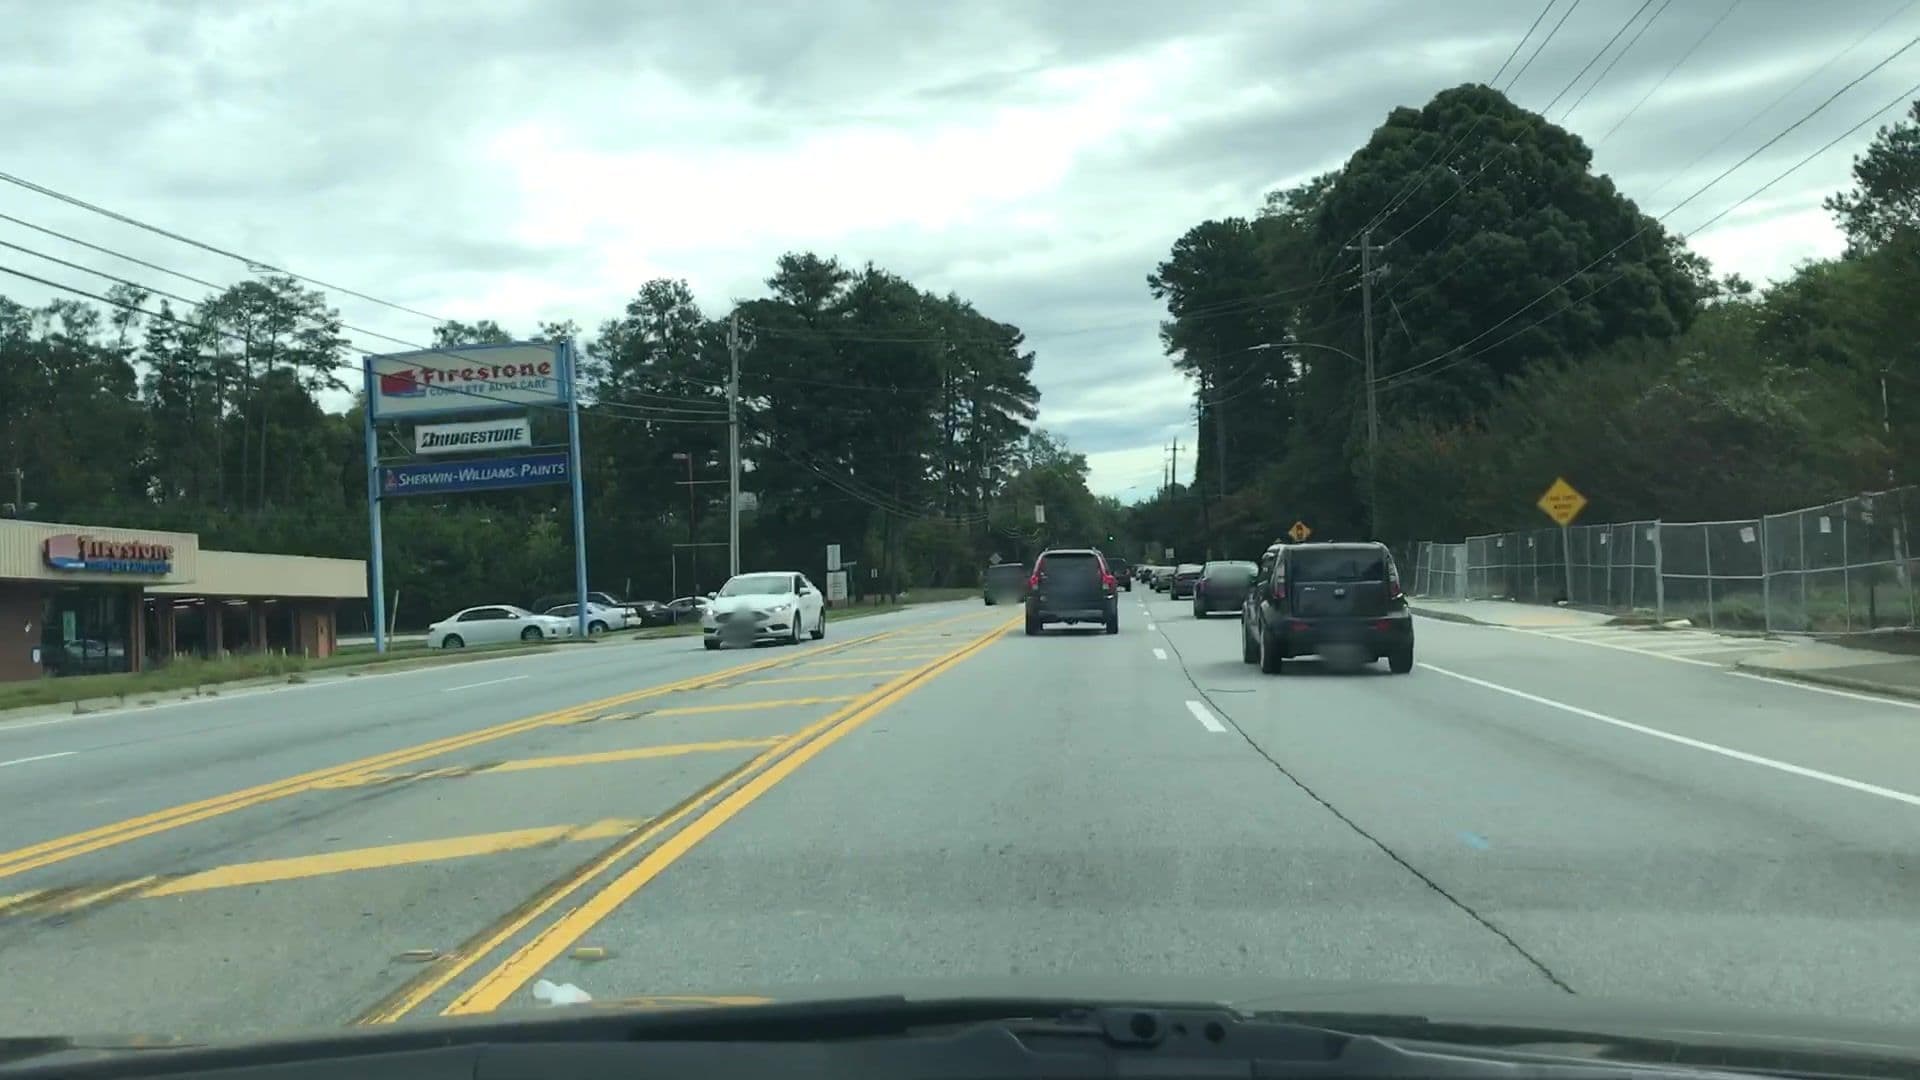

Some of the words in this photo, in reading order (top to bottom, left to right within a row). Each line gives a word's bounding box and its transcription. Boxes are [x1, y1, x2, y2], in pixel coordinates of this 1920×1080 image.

[421, 361, 551, 385] Firestone
[520, 378, 547, 390] CARE
[421, 427, 524, 448] BRIDGESTONE
[521, 463, 565, 478] PAINTS
